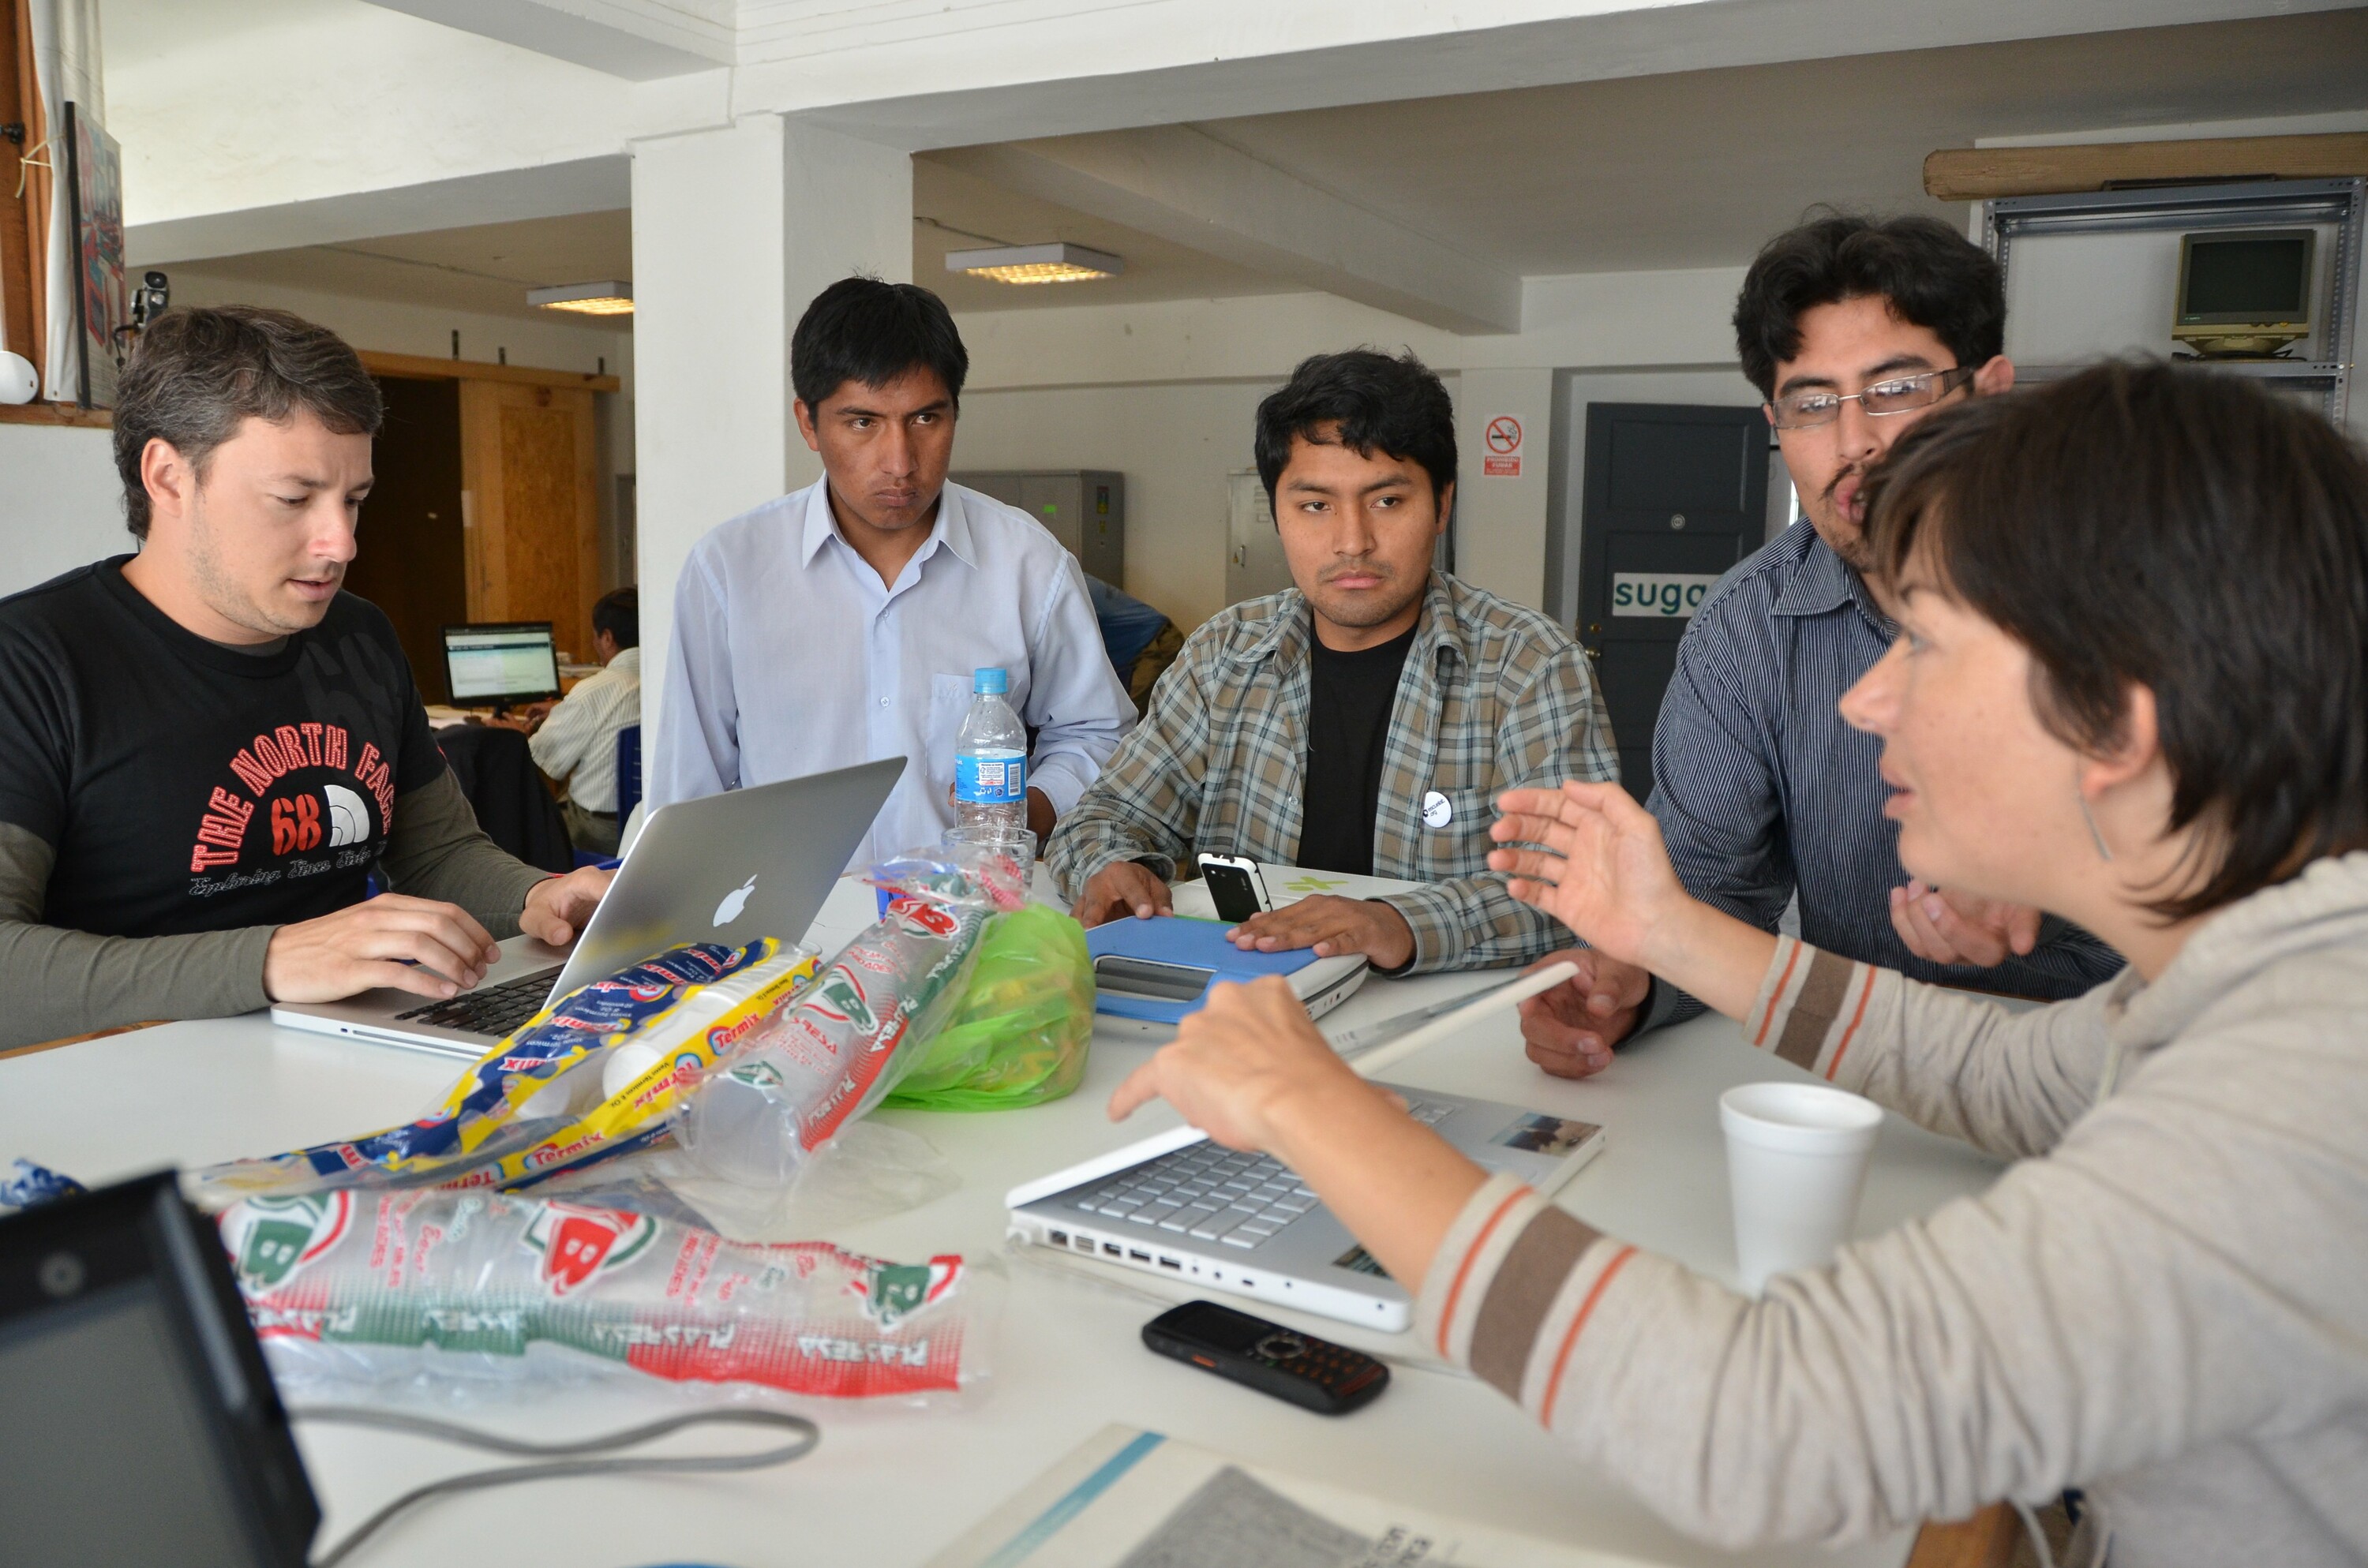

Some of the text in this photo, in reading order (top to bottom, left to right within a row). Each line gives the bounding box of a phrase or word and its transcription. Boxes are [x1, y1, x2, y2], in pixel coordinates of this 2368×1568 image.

[189, 785, 255, 873] THE
[229, 722, 348, 798] NORTH
[271, 794, 322, 856] 68
[714, 1013, 759, 1049] Termix
[653, 1062, 669, 1076] Vasos
[533, 1131, 606, 1166] Termix
